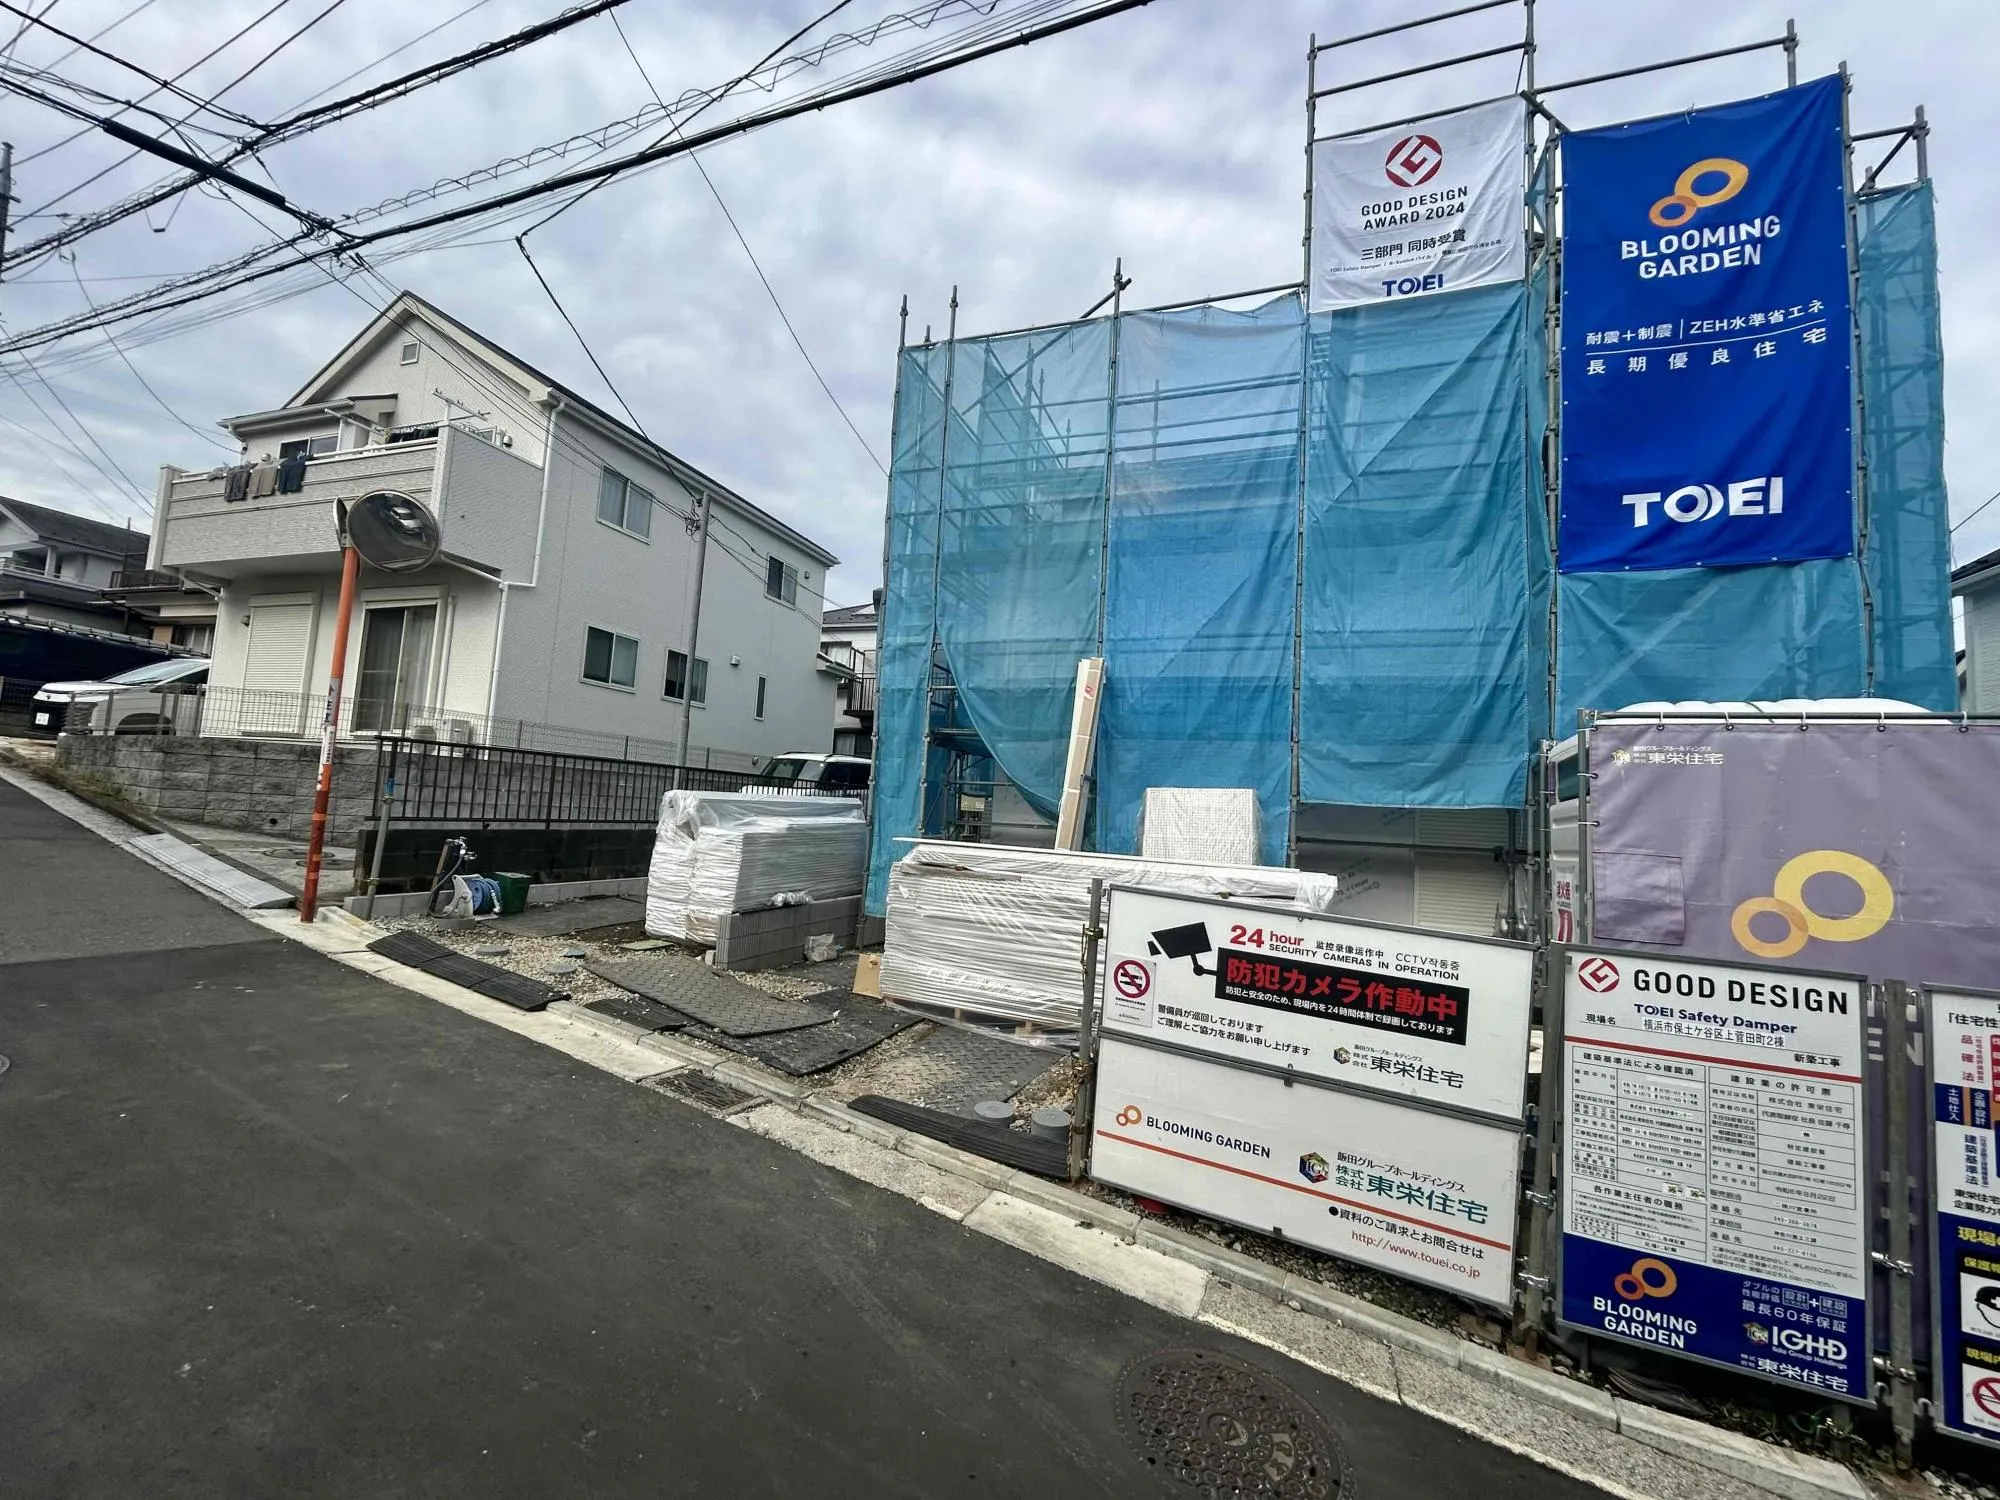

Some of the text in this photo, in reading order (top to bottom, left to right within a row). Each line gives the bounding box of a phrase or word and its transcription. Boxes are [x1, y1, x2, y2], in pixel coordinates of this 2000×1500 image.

[1361, 186, 1468, 216] GOOD DESIGN
[1363, 202, 1465, 230] AWARD 2024
[1361, 243, 1402, 260] 三部門
[1408, 228, 1467, 253] 同時受賞
[1621, 215, 1781, 260] BLOOMING
[1639, 243, 1761, 280] GARDEN
[1382, 273, 1443, 297] TOEI
[1586, 327, 1828, 376] 長期優良住宅
[1622, 476, 1784, 528] TOEI
[1648, 752, 1725, 765] 東栄住宅
[1230, 925, 1304, 948] 24 hour
[1269, 943, 1459, 981] SECURITY CAMERAS IN OPERATION
[1227, 958, 1458, 1021] 防犯カメラ作動中
[1633, 969, 1715, 999] GOOD
[1728, 980, 1848, 1015] DESIGN
[1157, 1016, 1311, 1056] ご理解とご協力をお願い申し上げます
[1158, 1004, 1264, 1033] 警備員が巡回しております
[1585, 1013, 1617, 1025] 現場名
[1633, 1003, 1798, 1035] TOEI Safety Damper
[1370, 1055, 1463, 1089] 東栄住宅
[1583, 1052, 1694, 1076] 建築基準法による確認済
[1793, 1053, 1841, 1068] 新築工事
[1961, 1034, 1975, 1082] 品確法
[1730, 1074, 1831, 1096] 建設業の許可票
[1948, 1088, 1960, 1122] 土地仕入
[1147, 1116, 1271, 1159] BLOOMING GARDEN
[1336, 1151, 1466, 1193] 飯田グループホールディングス
[1964, 1134, 1978, 1186] 建築基準法
[1366, 1174, 1489, 1225] 東栄住宅
[1594, 1184, 1684, 1211] 各作業主任者の職務
[1351, 1230, 1482, 1280] http://www.touei.co.jp
[1593, 1296, 1697, 1335] BLOOMING
[1604, 1316, 1684, 1348] GARDEN
[1742, 1299, 1847, 1334] 最長60年保証
[1772, 1326, 1848, 1361] IGHD
[1757, 1358, 1848, 1393] 東栄住宅
